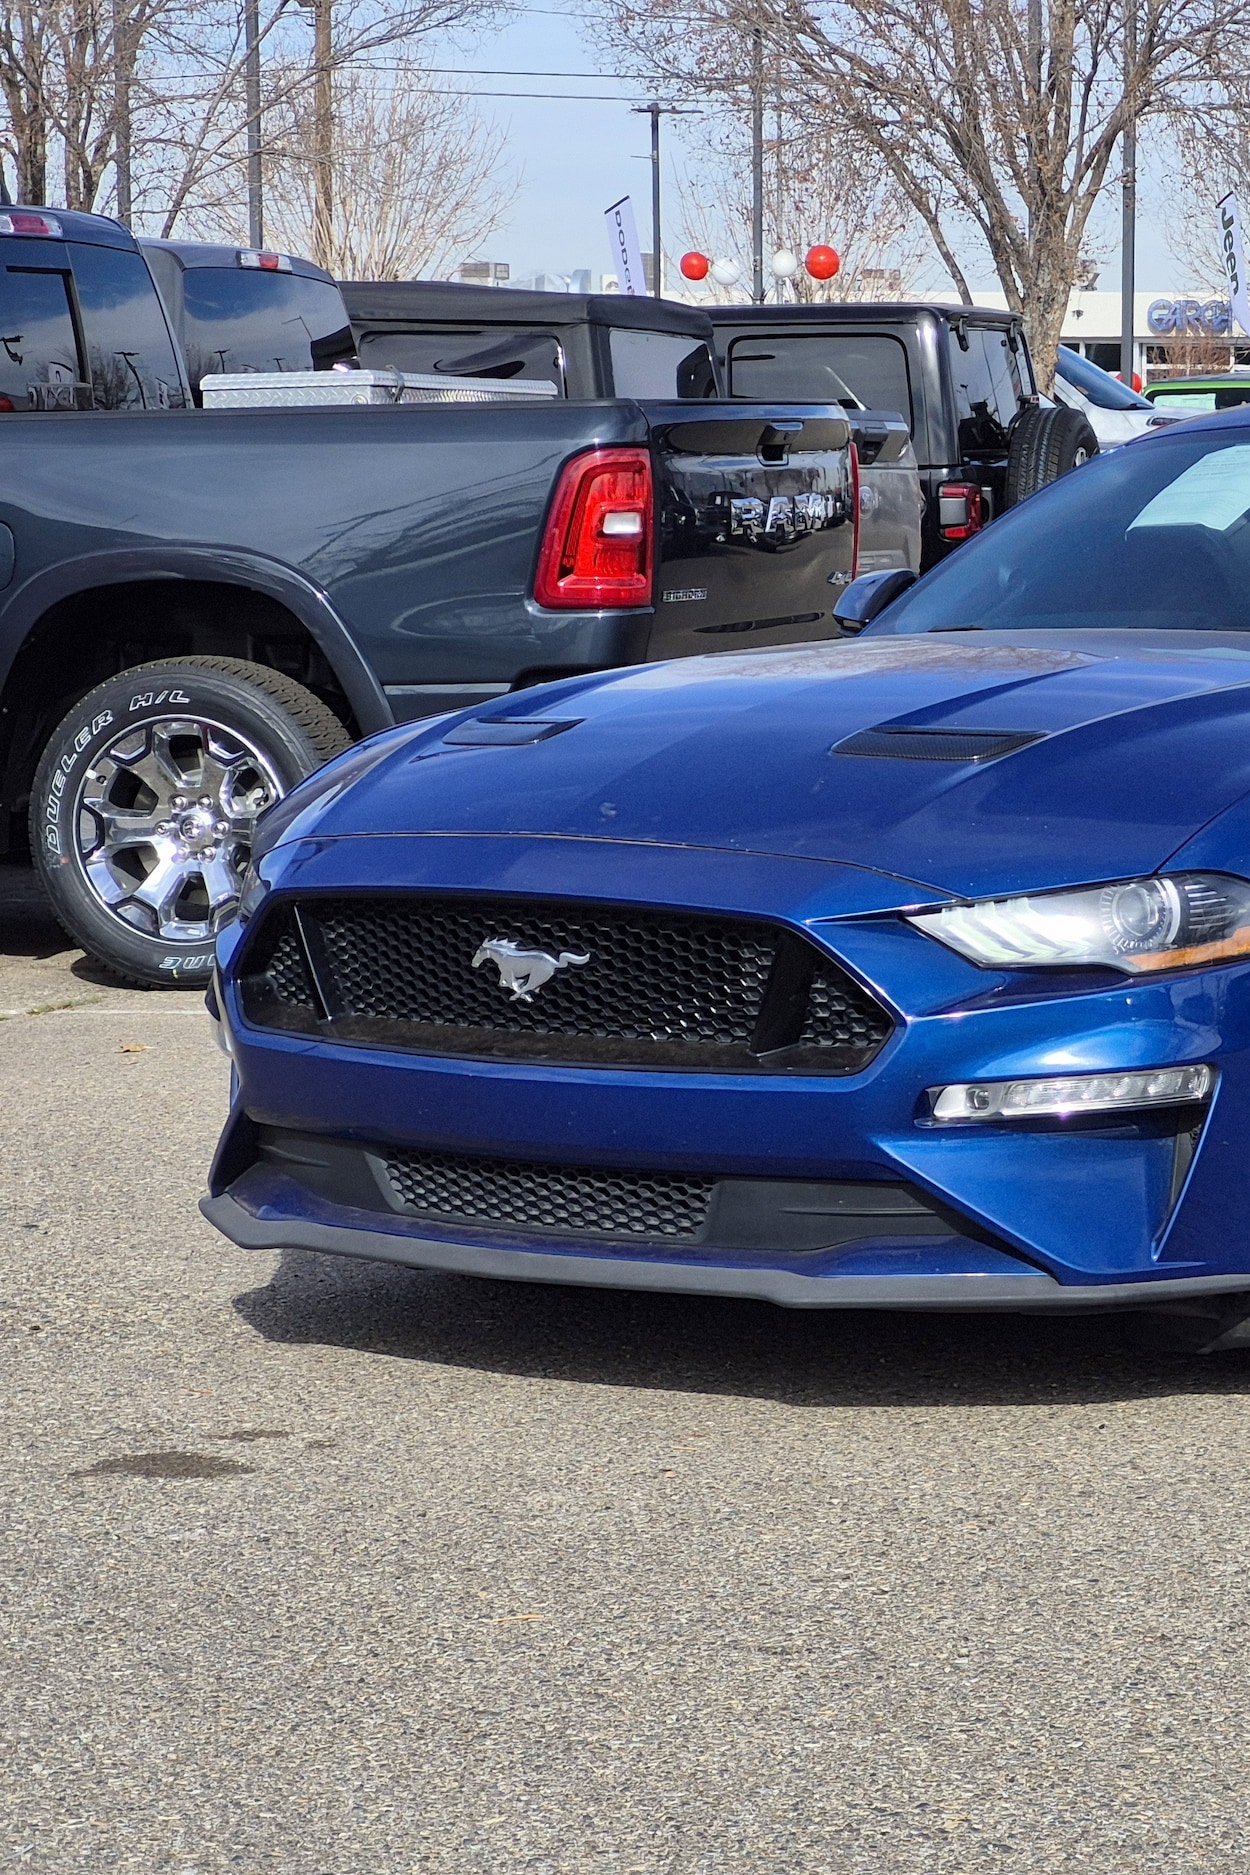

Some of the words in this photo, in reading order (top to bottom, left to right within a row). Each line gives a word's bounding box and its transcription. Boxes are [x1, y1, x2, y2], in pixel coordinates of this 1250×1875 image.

[1147, 299, 1233, 334] GARCI
[46, 709, 114, 854] DUELER
[129, 690, 191, 711] H/L
